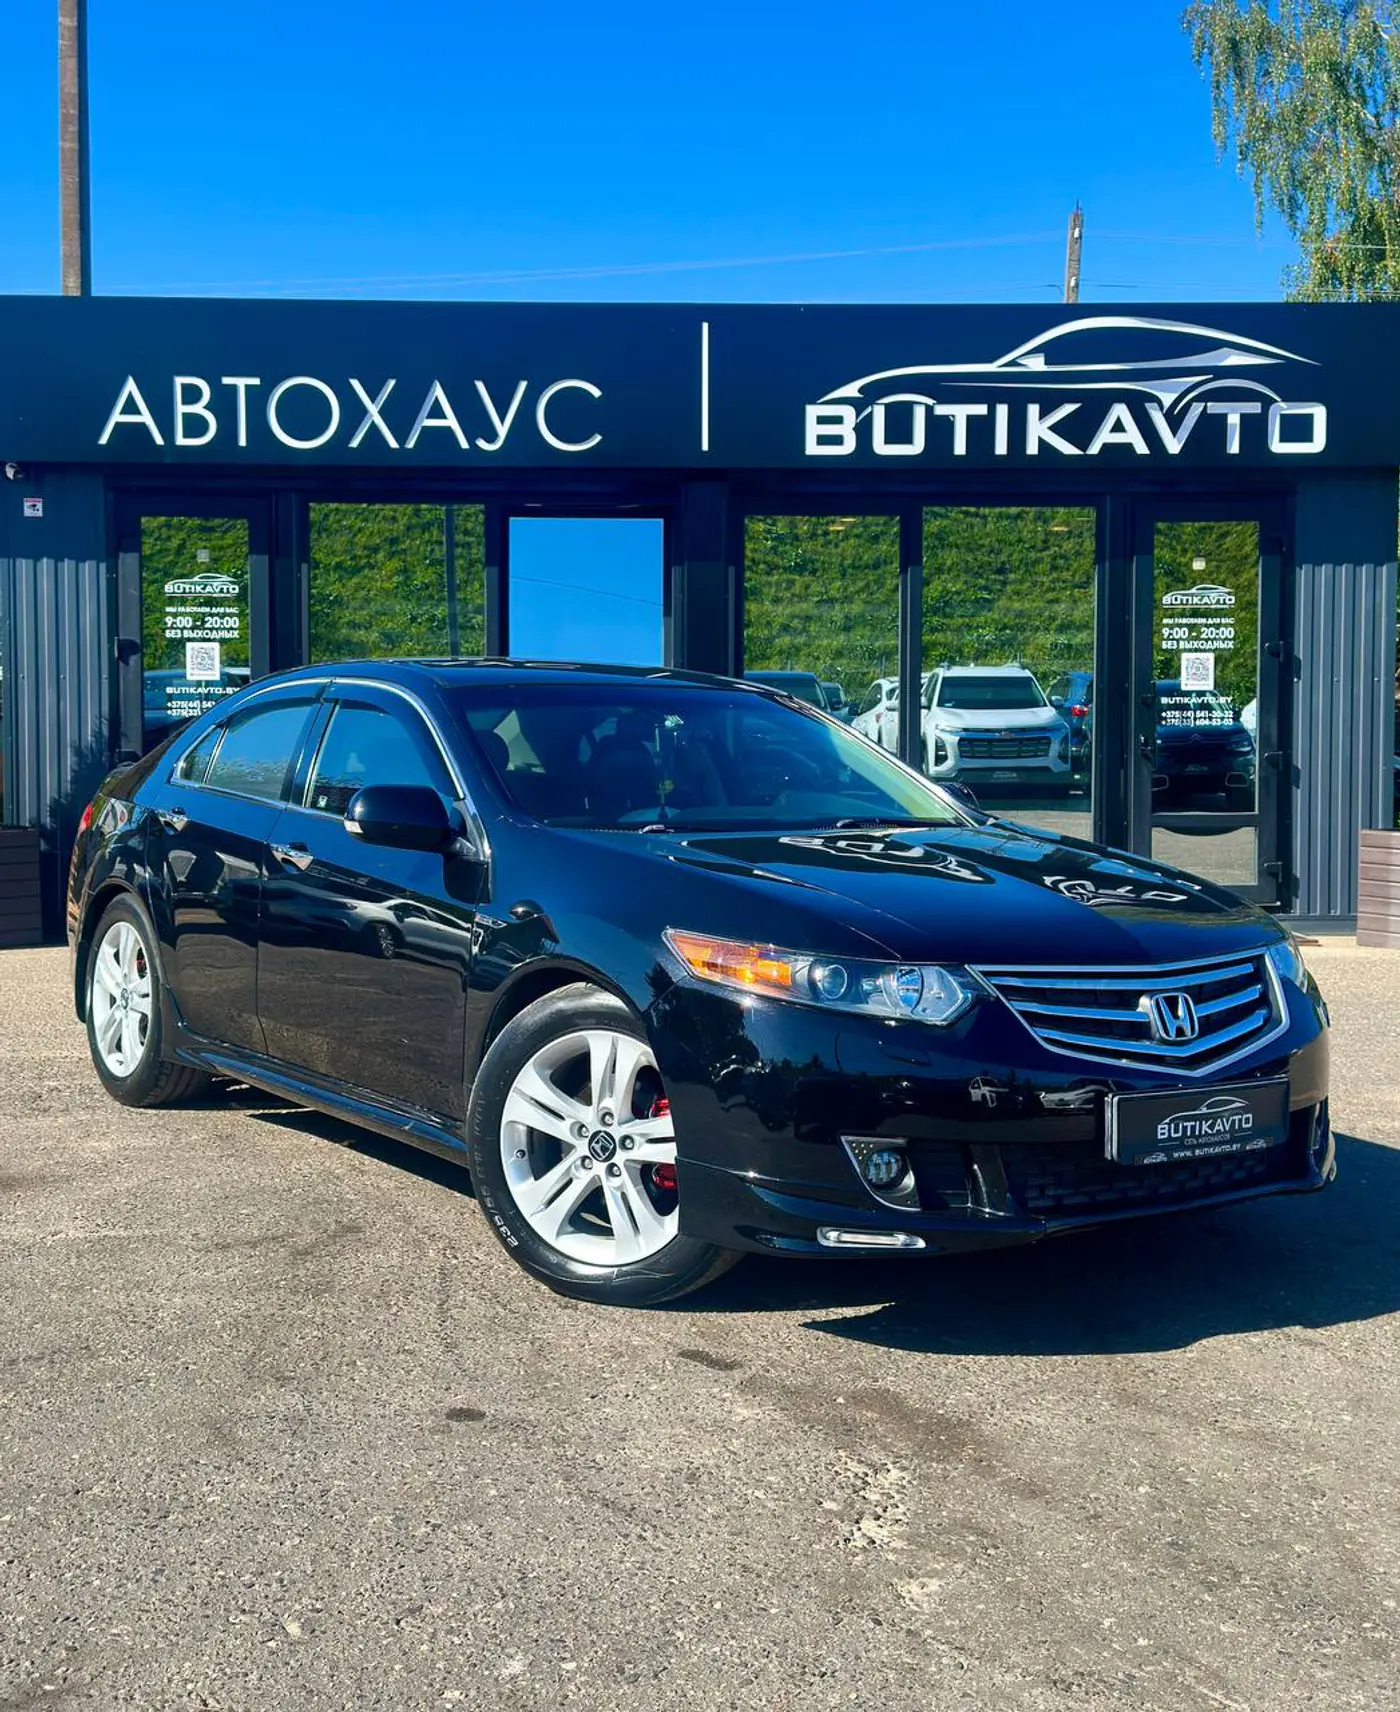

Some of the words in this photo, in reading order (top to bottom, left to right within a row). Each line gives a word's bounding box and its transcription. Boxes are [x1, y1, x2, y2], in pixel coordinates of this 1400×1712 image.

[97, 374, 603, 452] АВТОХАУС
[804, 402, 1328, 456] BUTIKAVTO
[164, 584, 240, 594] BUTIKAVTO
[1161, 594, 1236, 605] BUTIKAVTO
[165, 616, 193, 628] 9:00
[204, 616, 239, 628] 20:00
[165, 629, 182, 639] БЕЗ
[183, 629, 240, 640] ВЫХОДНЫХ
[1162, 627, 1189, 639] 9:00
[1200, 627, 1235, 639] 20:00
[1162, 640, 1178, 650] БЕЗ
[1179, 640, 1234, 650] ВЫХОДНЫХ
[1160, 696, 1233, 705] BUTIKAVTO.BY
[1156, 1113, 1253, 1140] BUTIKAVTO
